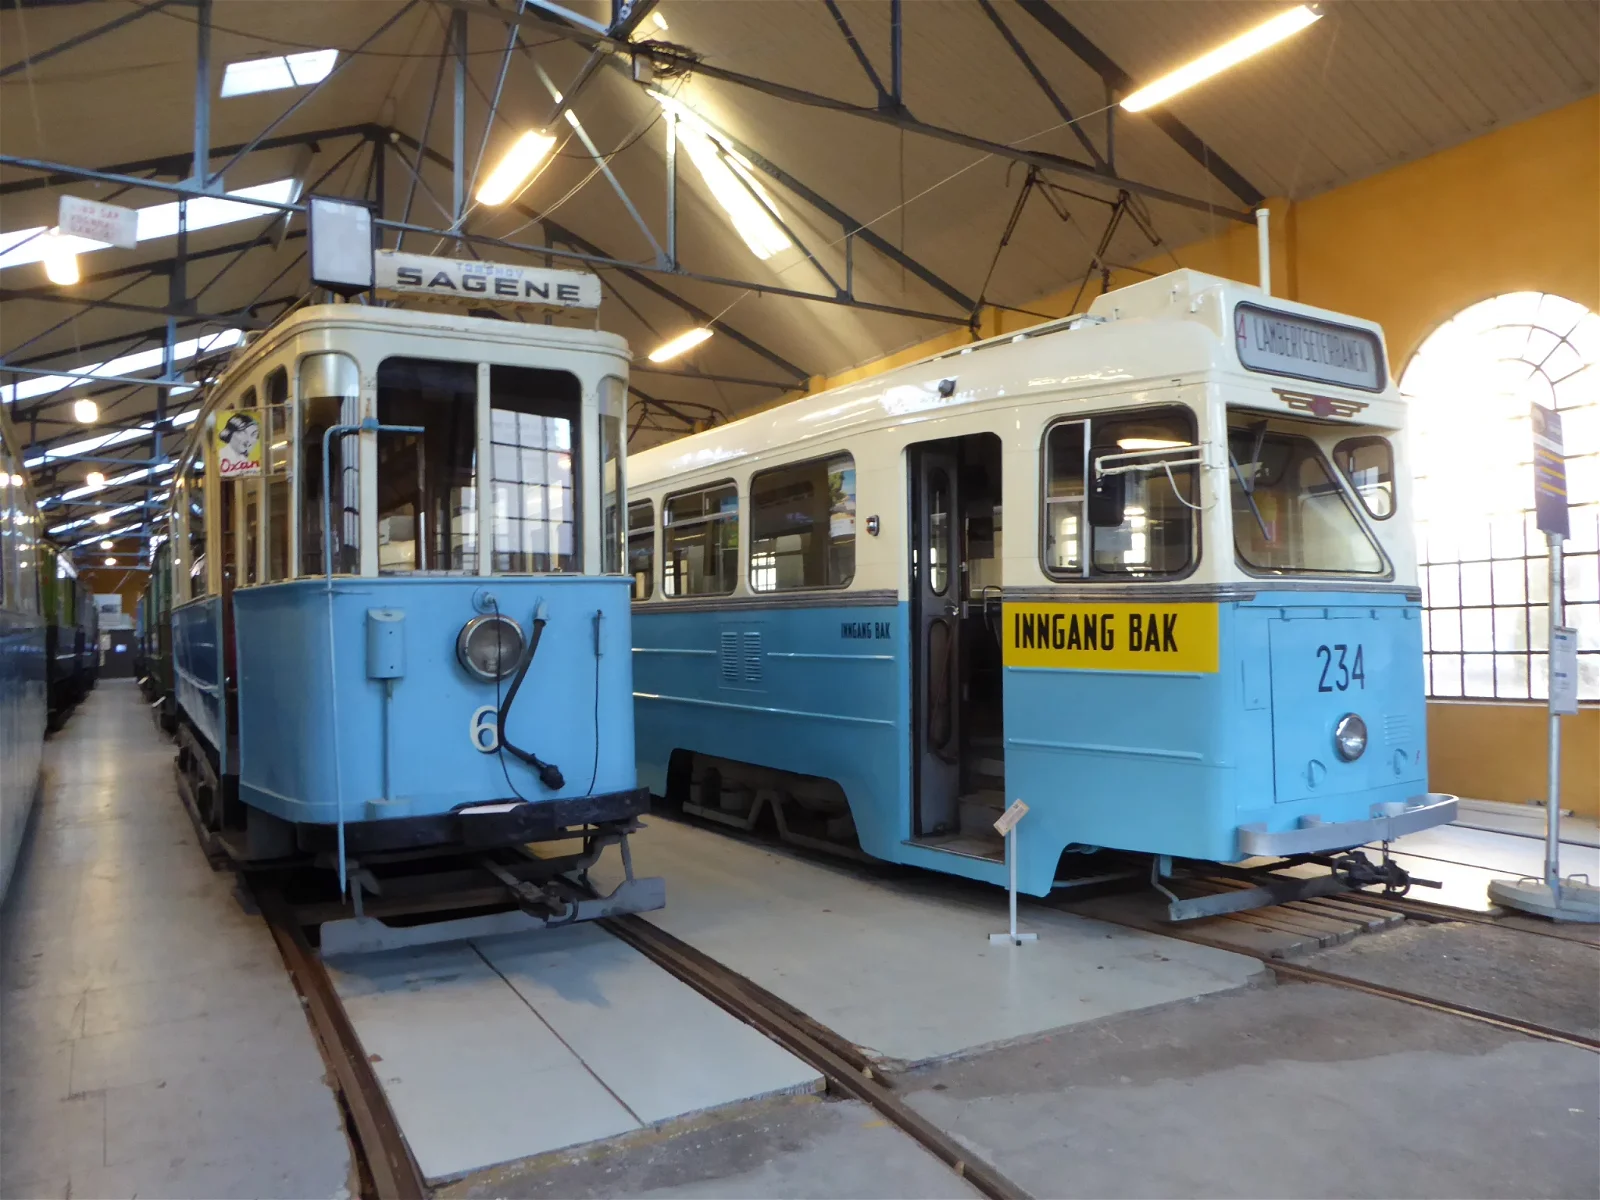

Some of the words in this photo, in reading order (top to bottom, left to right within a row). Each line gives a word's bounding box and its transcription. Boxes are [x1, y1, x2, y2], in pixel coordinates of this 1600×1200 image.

[397, 267, 580, 303] SAGENE
[1238, 313, 1248, 349] 4
[840, 622, 872, 640] INNGANG
[874, 621, 892, 640] BAK
[1014, 612, 1115, 652] INNGANG
[1128, 612, 1179, 653] BAK
[1316, 643, 1365, 693] 234
[469, 705, 501, 754] 6
